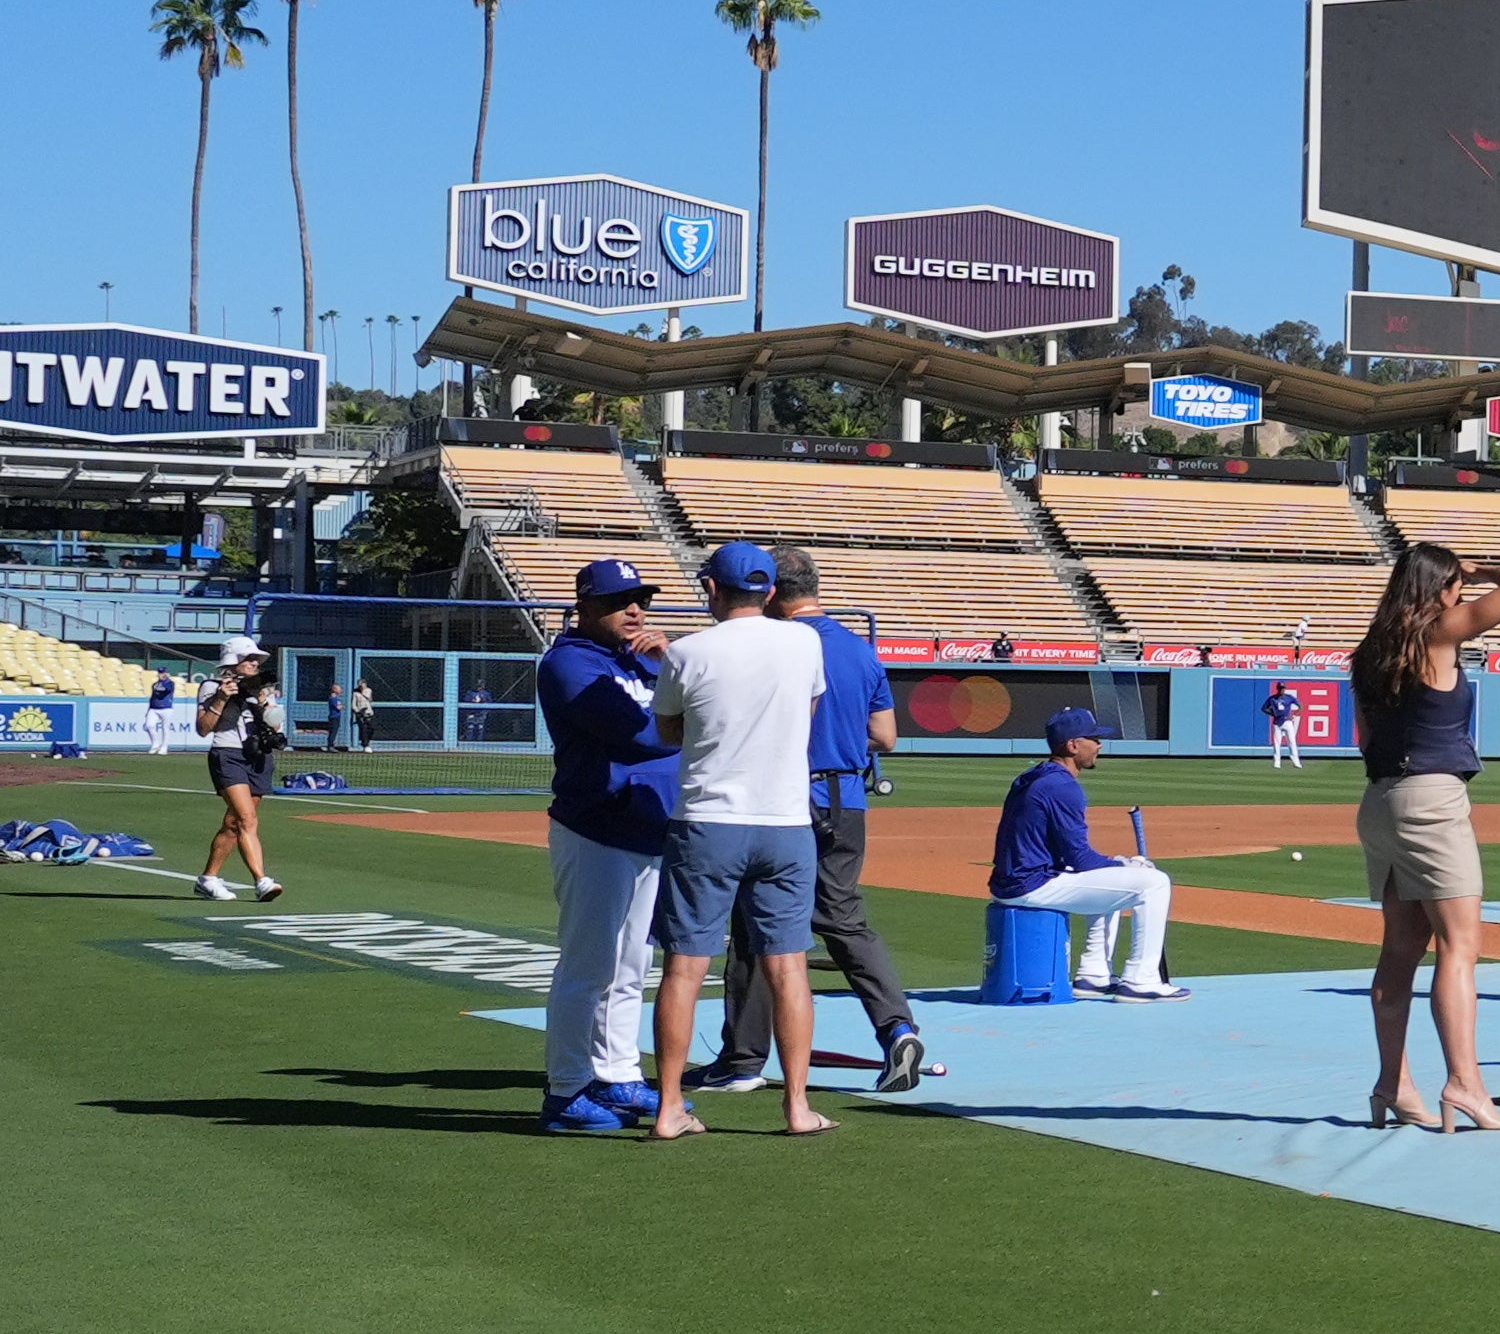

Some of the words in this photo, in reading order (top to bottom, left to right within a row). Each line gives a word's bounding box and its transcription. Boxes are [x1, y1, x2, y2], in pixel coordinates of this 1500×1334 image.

[484, 194, 641, 258] blue
[508, 258, 659, 289] california
[873, 254, 1096, 288] GUGGENHEIM
[0, 350, 291, 417] TWATER
[1164, 383, 1233, 403] TOYO
[1175, 400, 1249, 419] TIRES
[814, 442, 860, 456] prefers
[1178, 458, 1219, 470] prefers
[616, 561, 637, 580] LA
[877, 646, 891, 655] UN
[894, 646, 928, 656] MAGIC
[1031, 649, 1067, 659] EVERY
[1069, 650, 1096, 659] TIME
[1235, 654, 1256, 663] RUN
[1258, 654, 1289, 664] MAGIC
[93, 721, 138, 733] BANK
